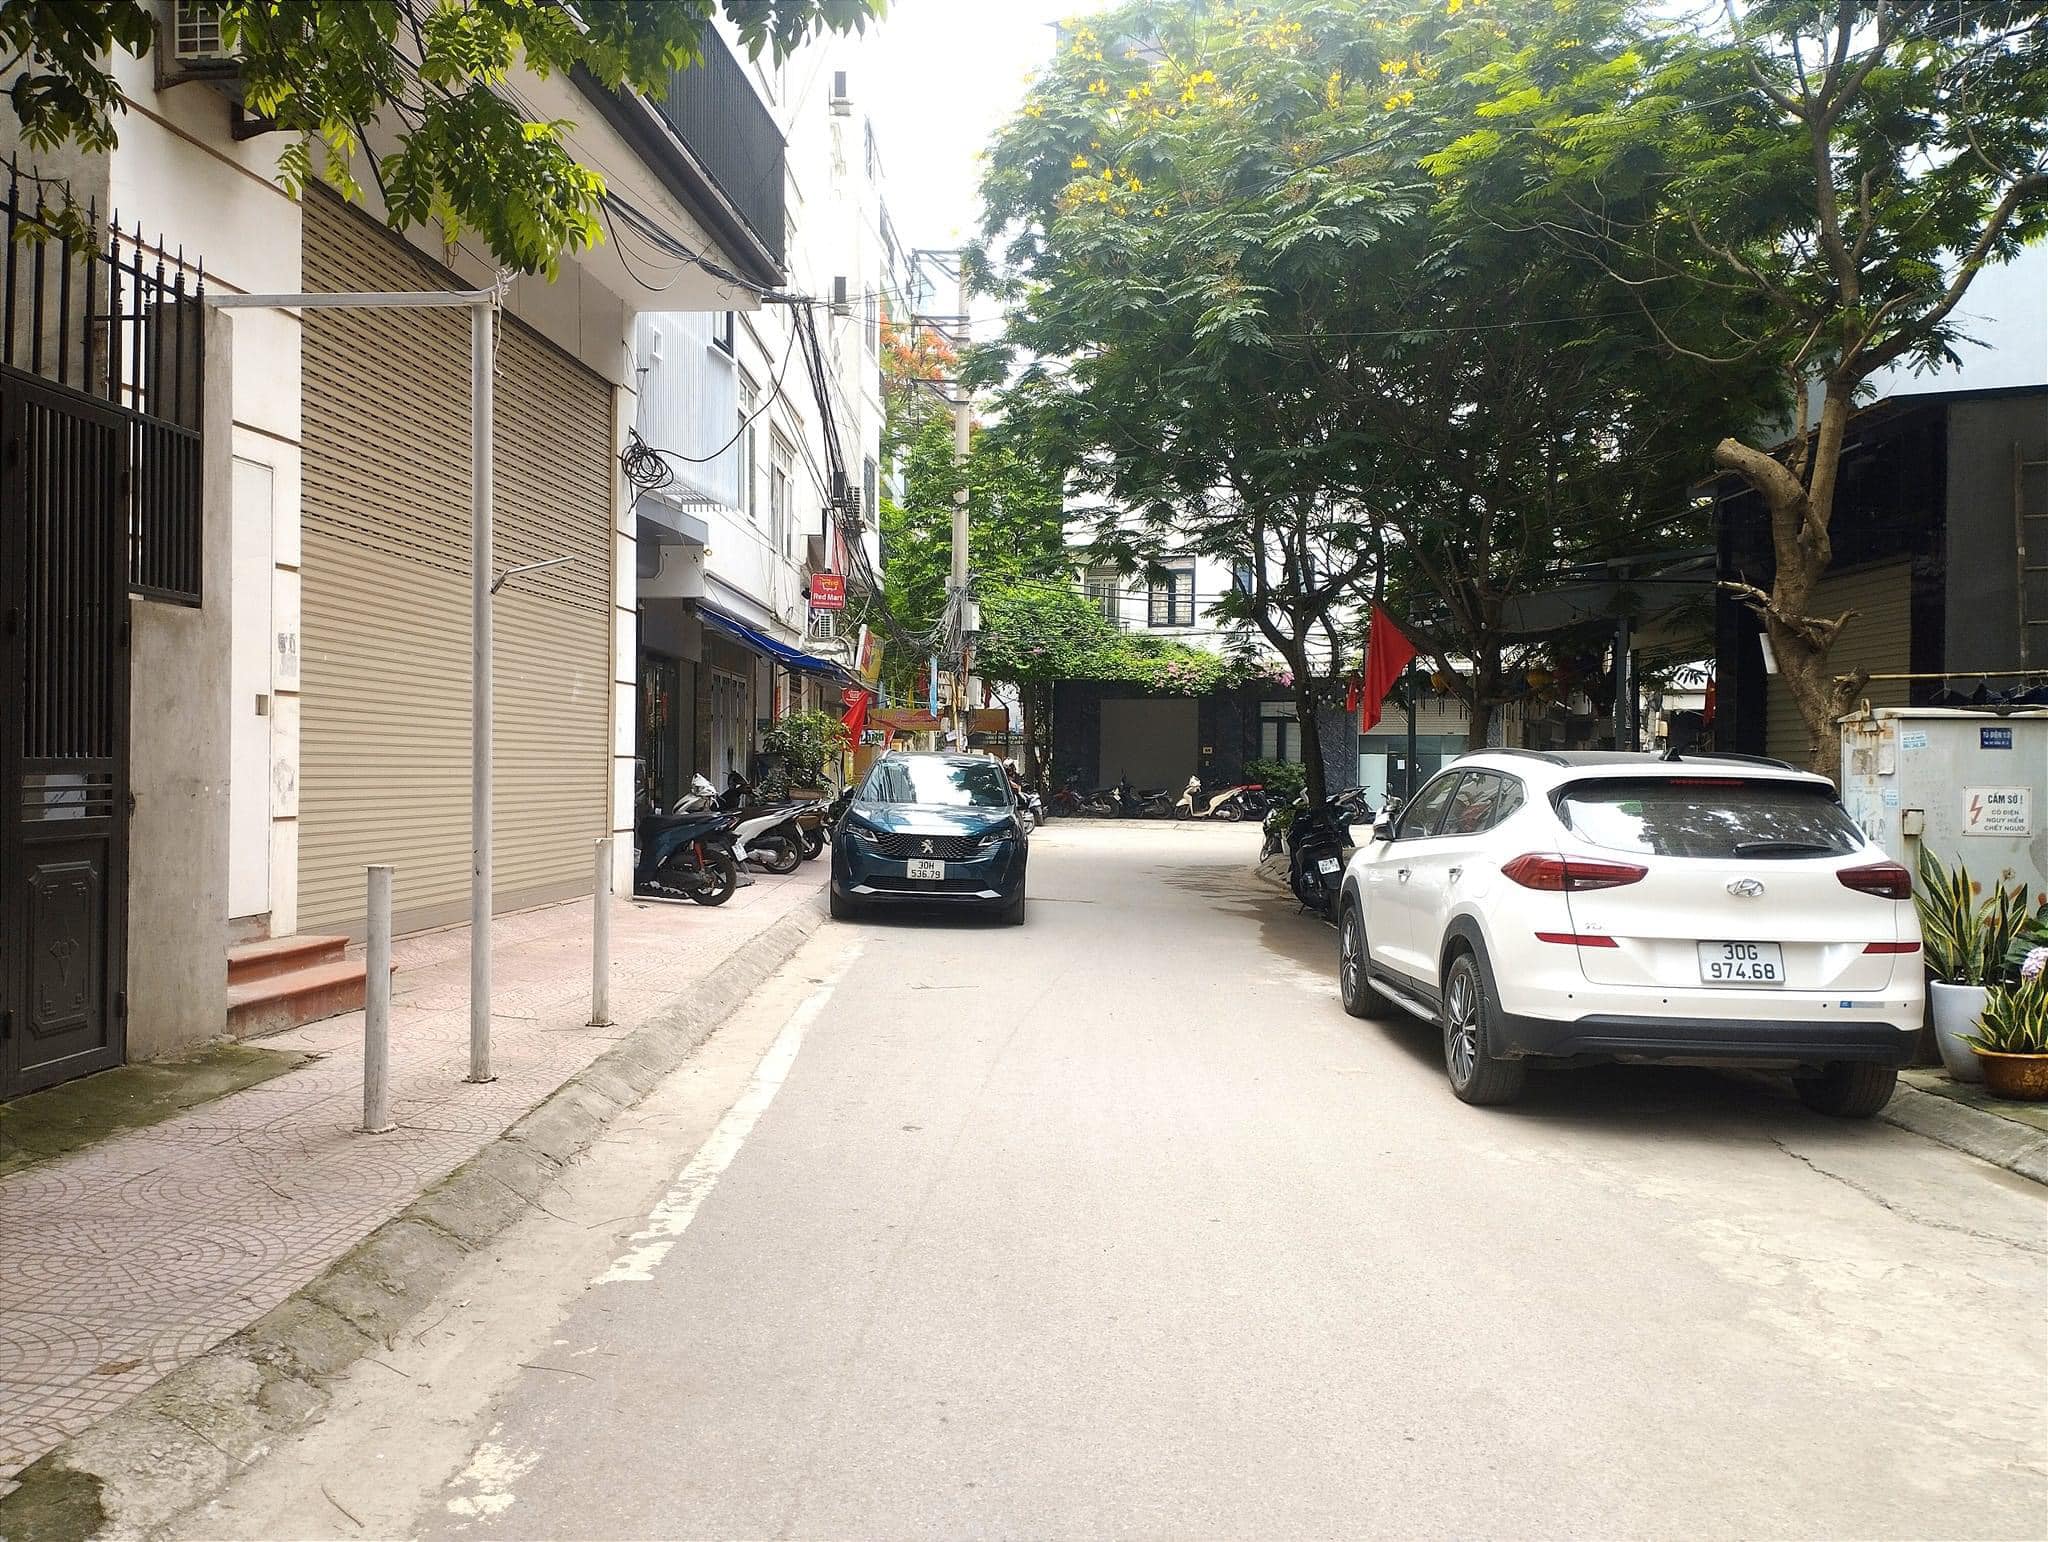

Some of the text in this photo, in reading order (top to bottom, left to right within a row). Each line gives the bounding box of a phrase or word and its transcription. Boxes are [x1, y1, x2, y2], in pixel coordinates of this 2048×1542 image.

[813, 592, 843, 601] Red Mart
[918, 860, 935, 870] 30H
[911, 869, 941, 879] 536.79
[1723, 944, 1758, 960] 30G
[1711, 962, 1775, 979] 974.68
